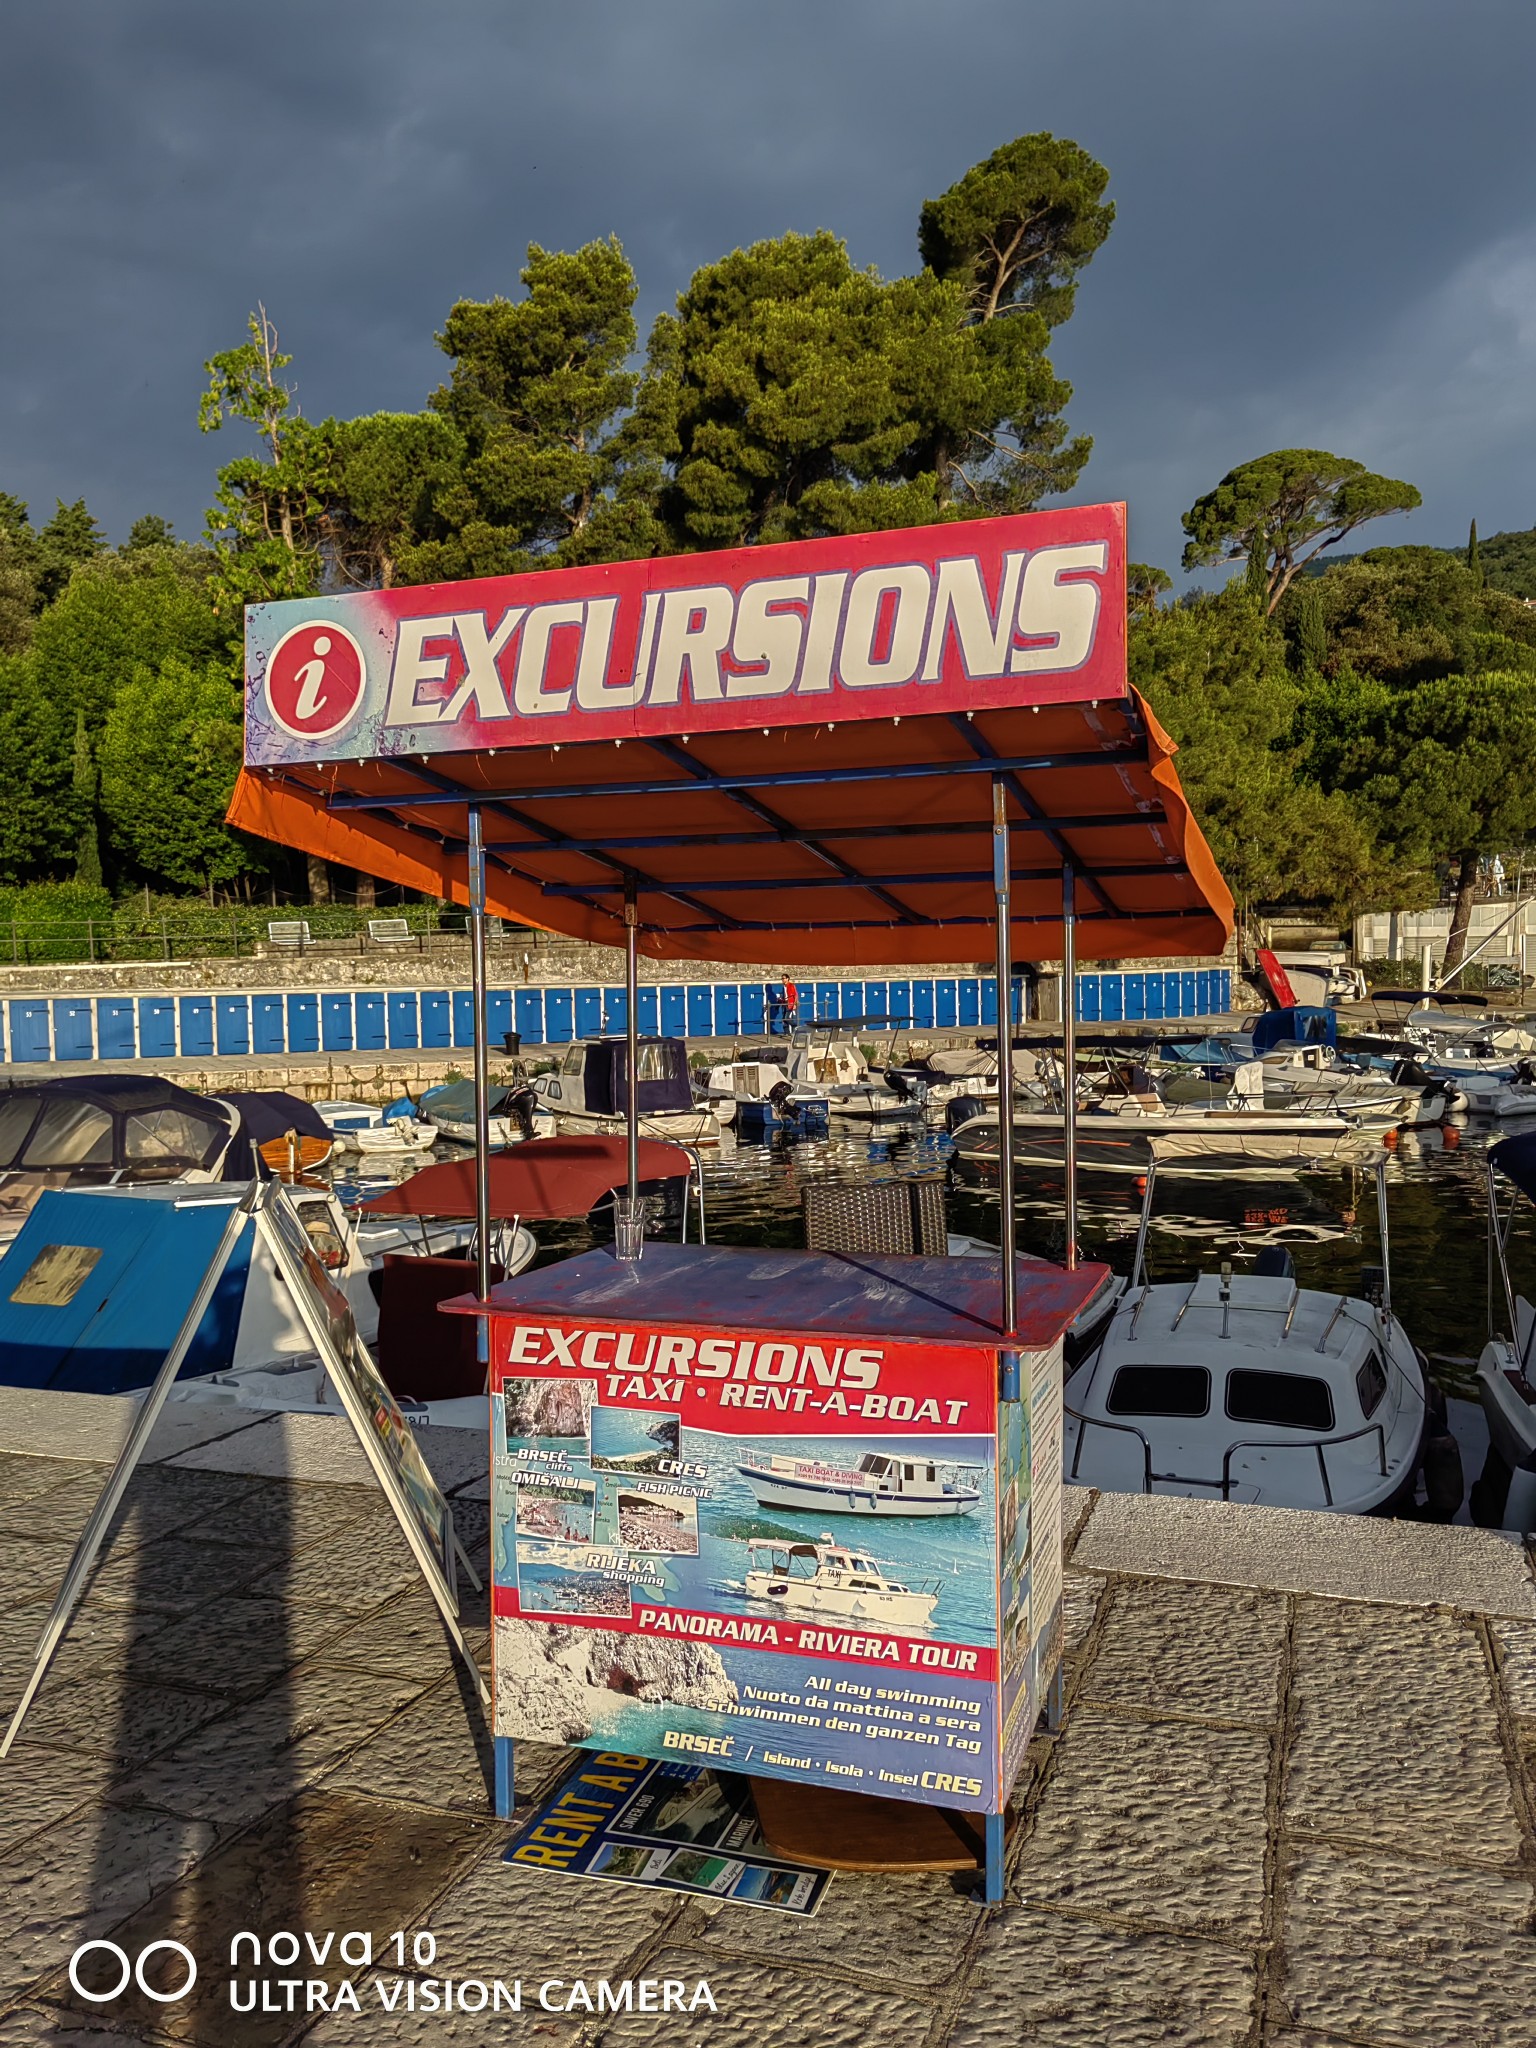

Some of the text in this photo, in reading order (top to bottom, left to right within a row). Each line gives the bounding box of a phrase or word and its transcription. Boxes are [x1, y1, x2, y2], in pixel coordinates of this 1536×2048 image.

[384, 542, 1108, 727] EXCURSIONS
[508, 1326, 884, 1389] EXCURSIONS
[605, 1373, 968, 1425] TAXI RENT-A-BOAT
[517, 1448, 568, 1463] BRSEČ
[545, 1463, 573, 1472] cliffs
[657, 1459, 708, 1478] CRES
[799, 1465, 814, 1474] TAXI
[815, 1468, 834, 1476] BOAT
[841, 1471, 863, 1480] DIVING
[637, 1482, 713, 1498] FISH PICNIC
[586, 1553, 657, 1575] RIJEKA
[602, 1570, 665, 1587] shopping
[827, 1568, 842, 1579] TAXI
[638, 1609, 779, 1645] PANORAMA
[798, 1629, 900, 1661] RIVIERA
[908, 1643, 978, 1671] TOUR
[742, 1685, 981, 1732] Nuoto da mattina a sera
[804, 1675, 982, 1716] All day swimming
[704, 1699, 982, 1755] Schwimmen den ganzen Tag
[662, 1730, 735, 1757] BRSEČ
[762, 1750, 812, 1769] Island
[824, 1760, 864, 1778] Isola
[878, 1768, 918, 1786] Insel
[920, 1770, 983, 1796] CRES
[511, 1791, 616, 1869] RENT
[578, 1773, 637, 1793] A
[619, 1807, 646, 1829] SAVER
